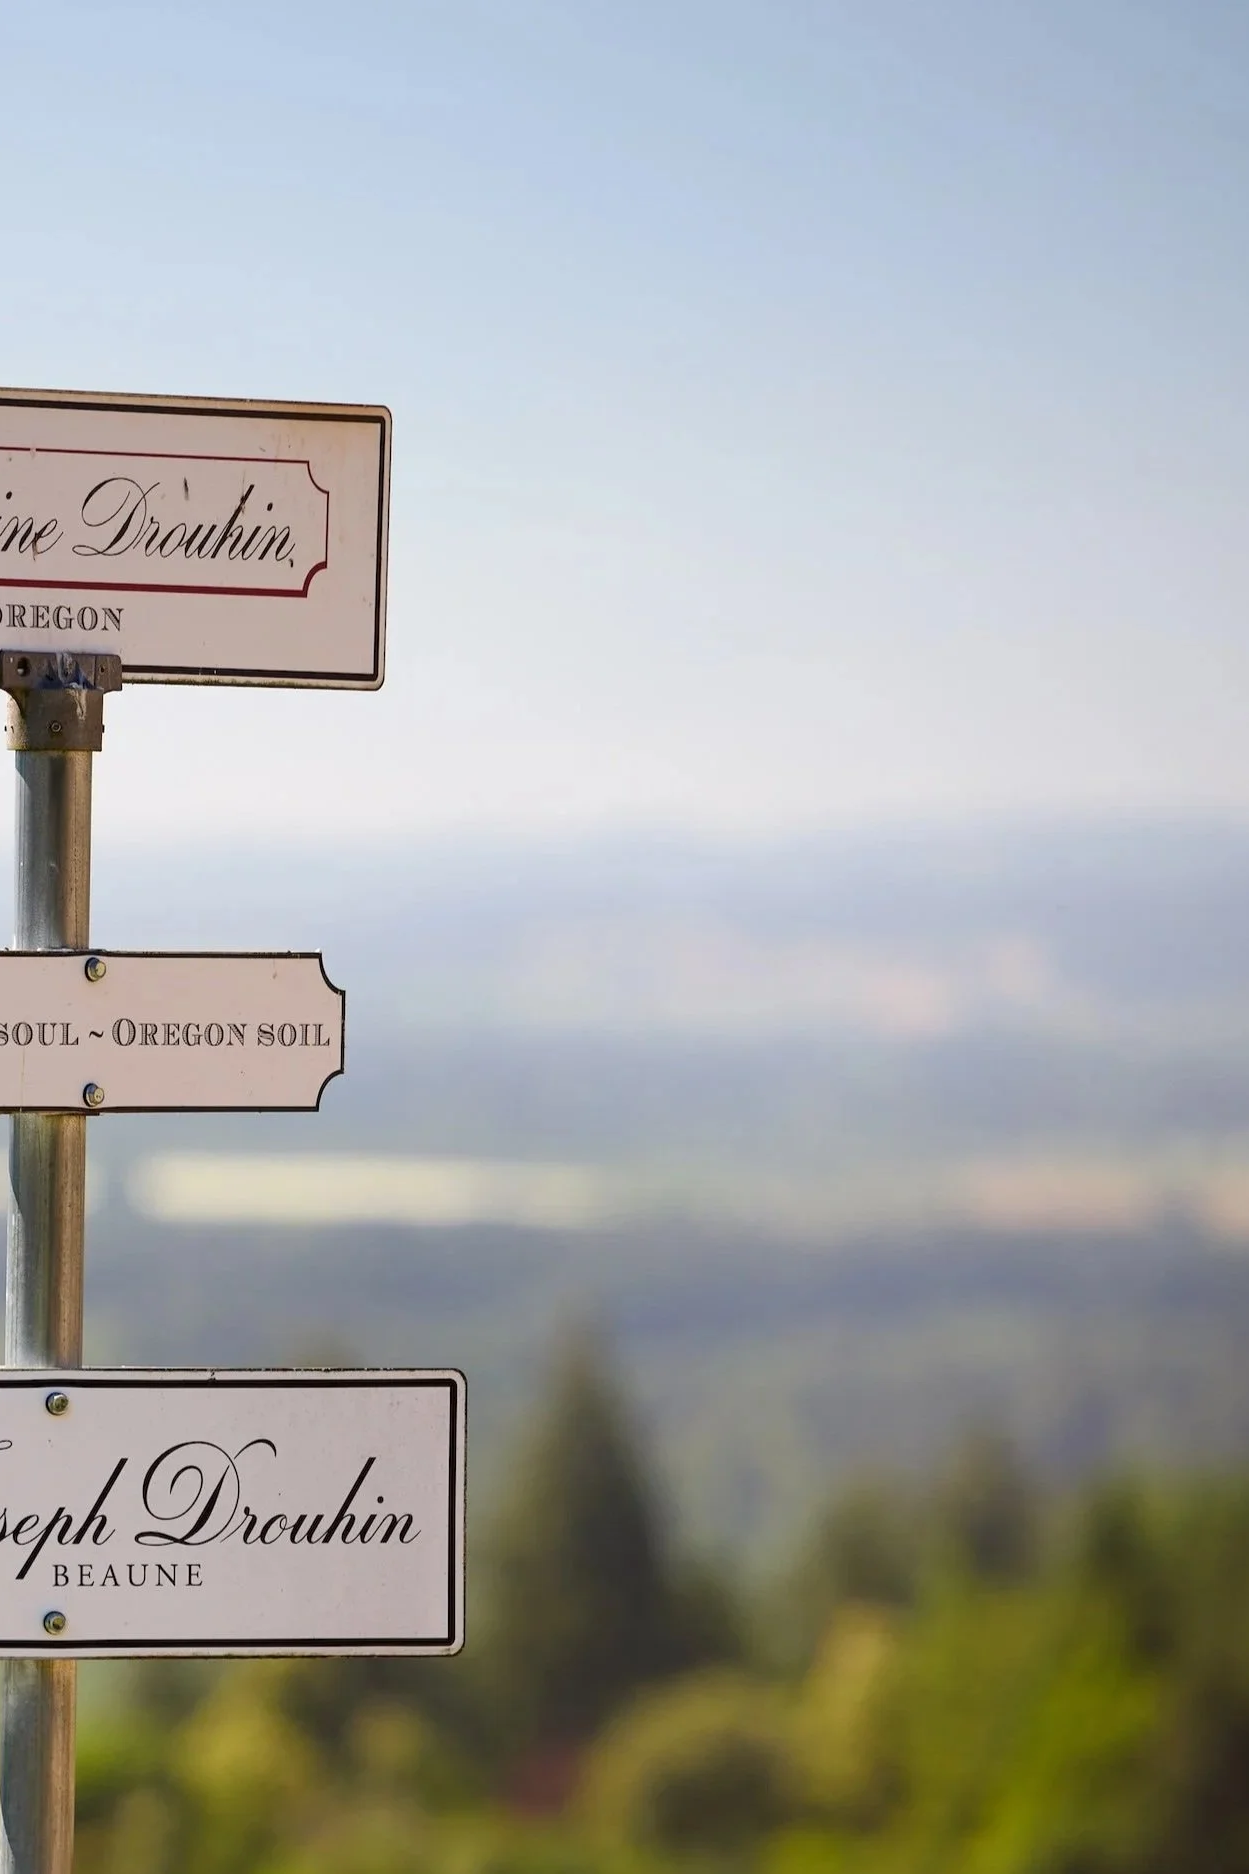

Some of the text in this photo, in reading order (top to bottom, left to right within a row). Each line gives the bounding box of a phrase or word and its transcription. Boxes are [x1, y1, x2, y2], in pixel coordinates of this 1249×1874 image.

[73, 476, 296, 562] Drouhin
[111, 1018, 248, 1047] OREGON
[256, 1021, 331, 1047] SOIL
[134, 1438, 421, 1546] Drouhin
[52, 1563, 204, 1588] BEAUNE
